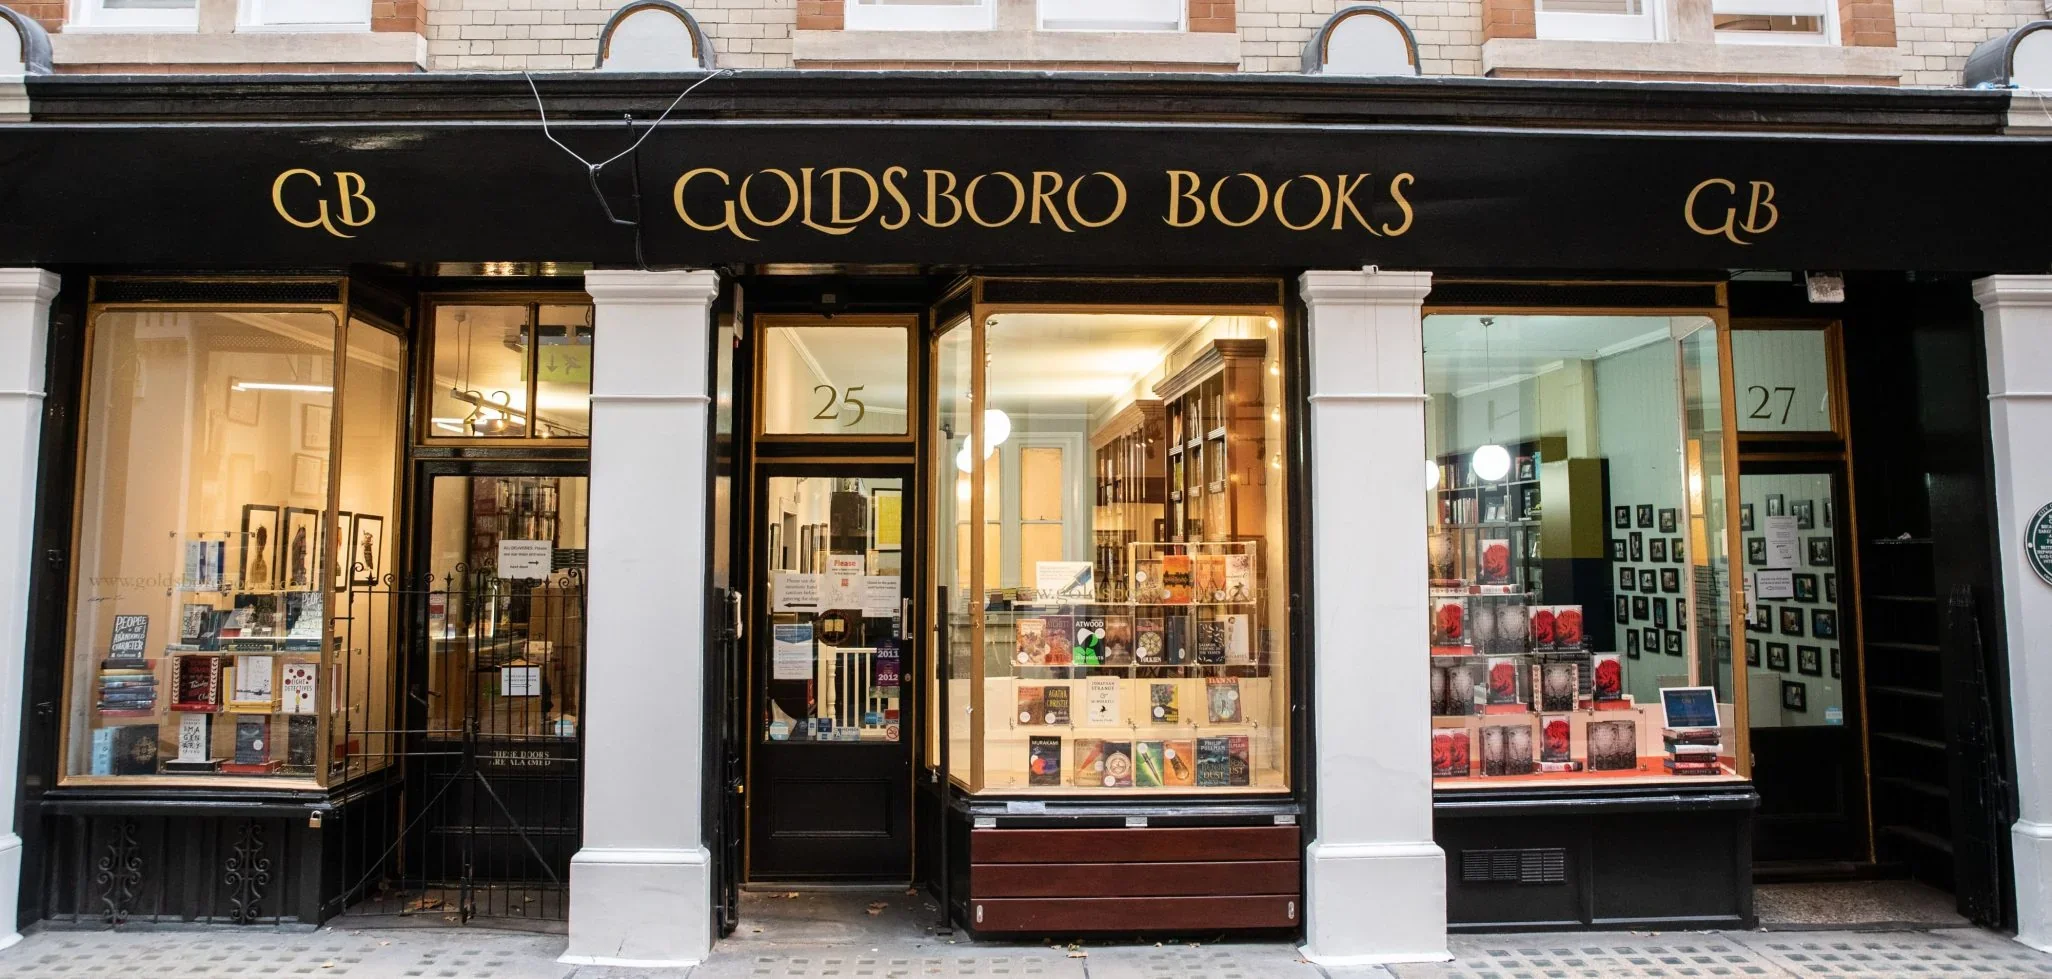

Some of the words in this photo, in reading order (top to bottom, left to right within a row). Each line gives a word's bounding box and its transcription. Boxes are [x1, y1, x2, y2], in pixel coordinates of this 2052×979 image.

[271, 168, 376, 238] GB
[673, 165, 1128, 241] GOLDSBORO
[1164, 170, 1415, 237] BOOKS
[1684, 178, 1779, 245] GB
[812, 384, 865, 428] 25
[1747, 385, 1796, 426] 27
[833, 559, 856, 567] Please
[115, 615, 147, 632] PEOPLE
[878, 673, 899, 681] 2012
[490, 750, 518, 758] HEE
